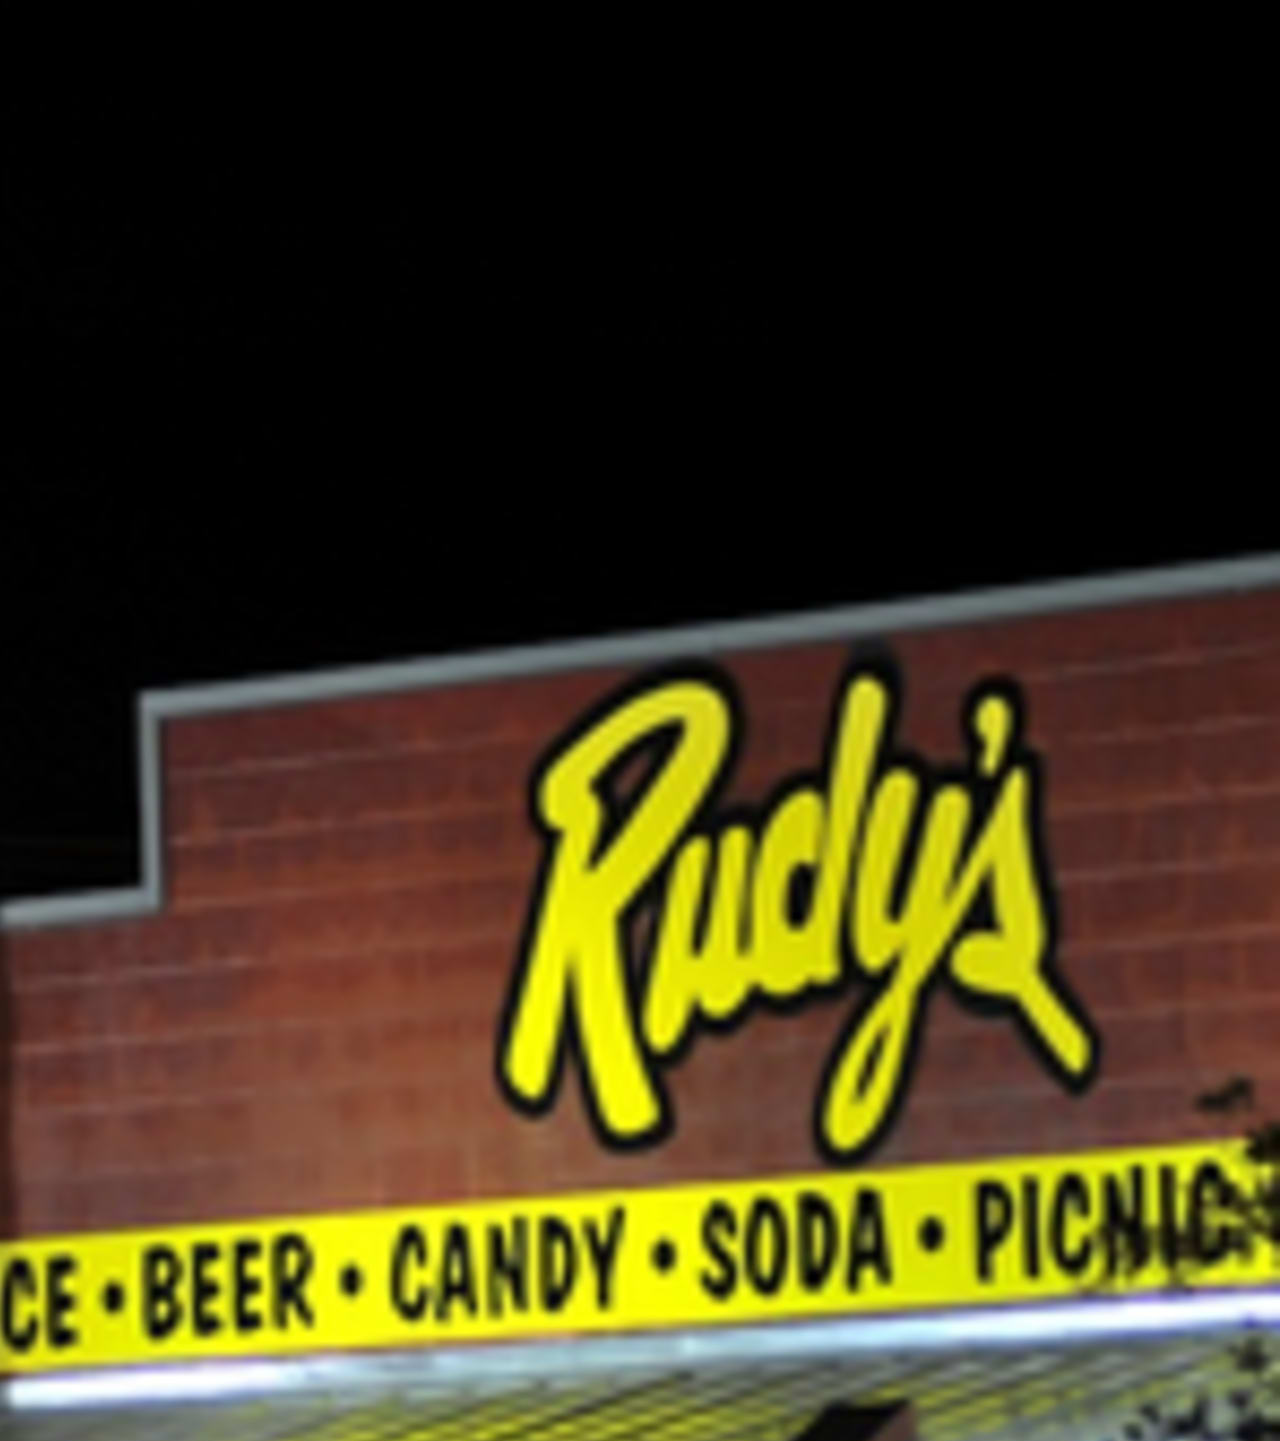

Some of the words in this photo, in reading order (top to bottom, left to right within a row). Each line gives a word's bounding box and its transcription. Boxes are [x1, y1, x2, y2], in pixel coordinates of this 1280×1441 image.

[495, 646, 1099, 1162] Rudy's
[142, 1232, 315, 1342] BEER
[391, 1206, 626, 1322] CANDY
[701, 1186, 892, 1302] SODA
